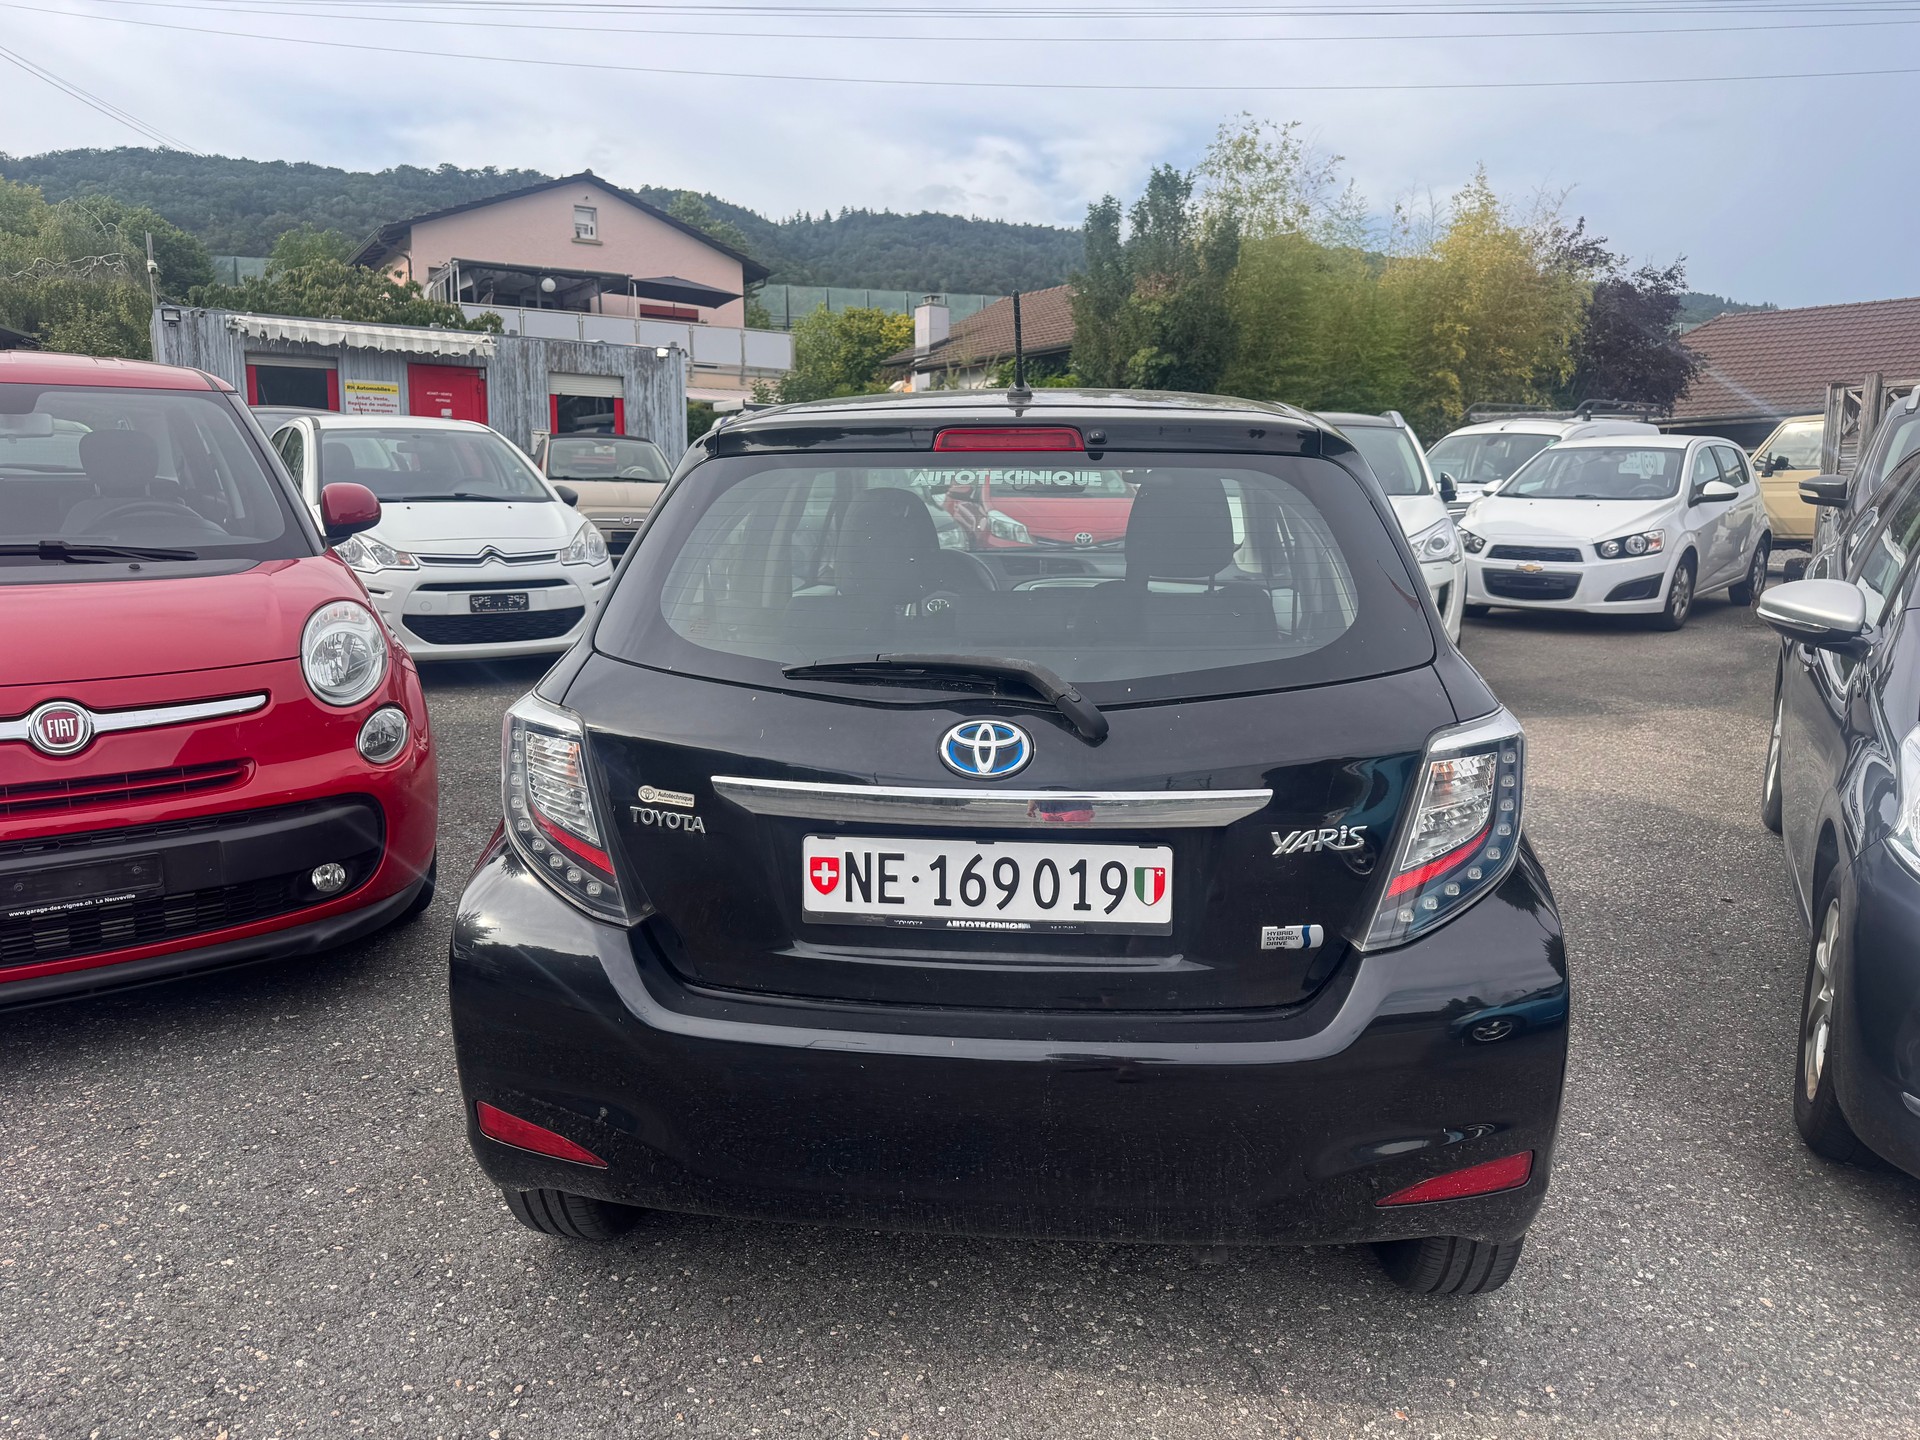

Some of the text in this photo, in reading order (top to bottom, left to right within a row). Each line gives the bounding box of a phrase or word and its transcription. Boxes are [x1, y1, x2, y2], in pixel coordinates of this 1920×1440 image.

[910, 470, 1102, 487] AUTOTECHNIQUE
[47, 718, 76, 739] FIAT
[657, 791, 693, 802] Autotechnique
[629, 805, 706, 834] TOYOTA
[8, 900, 93, 917] www.garage-des-vignes.ch
[104, 894, 136, 903] Neuveville
